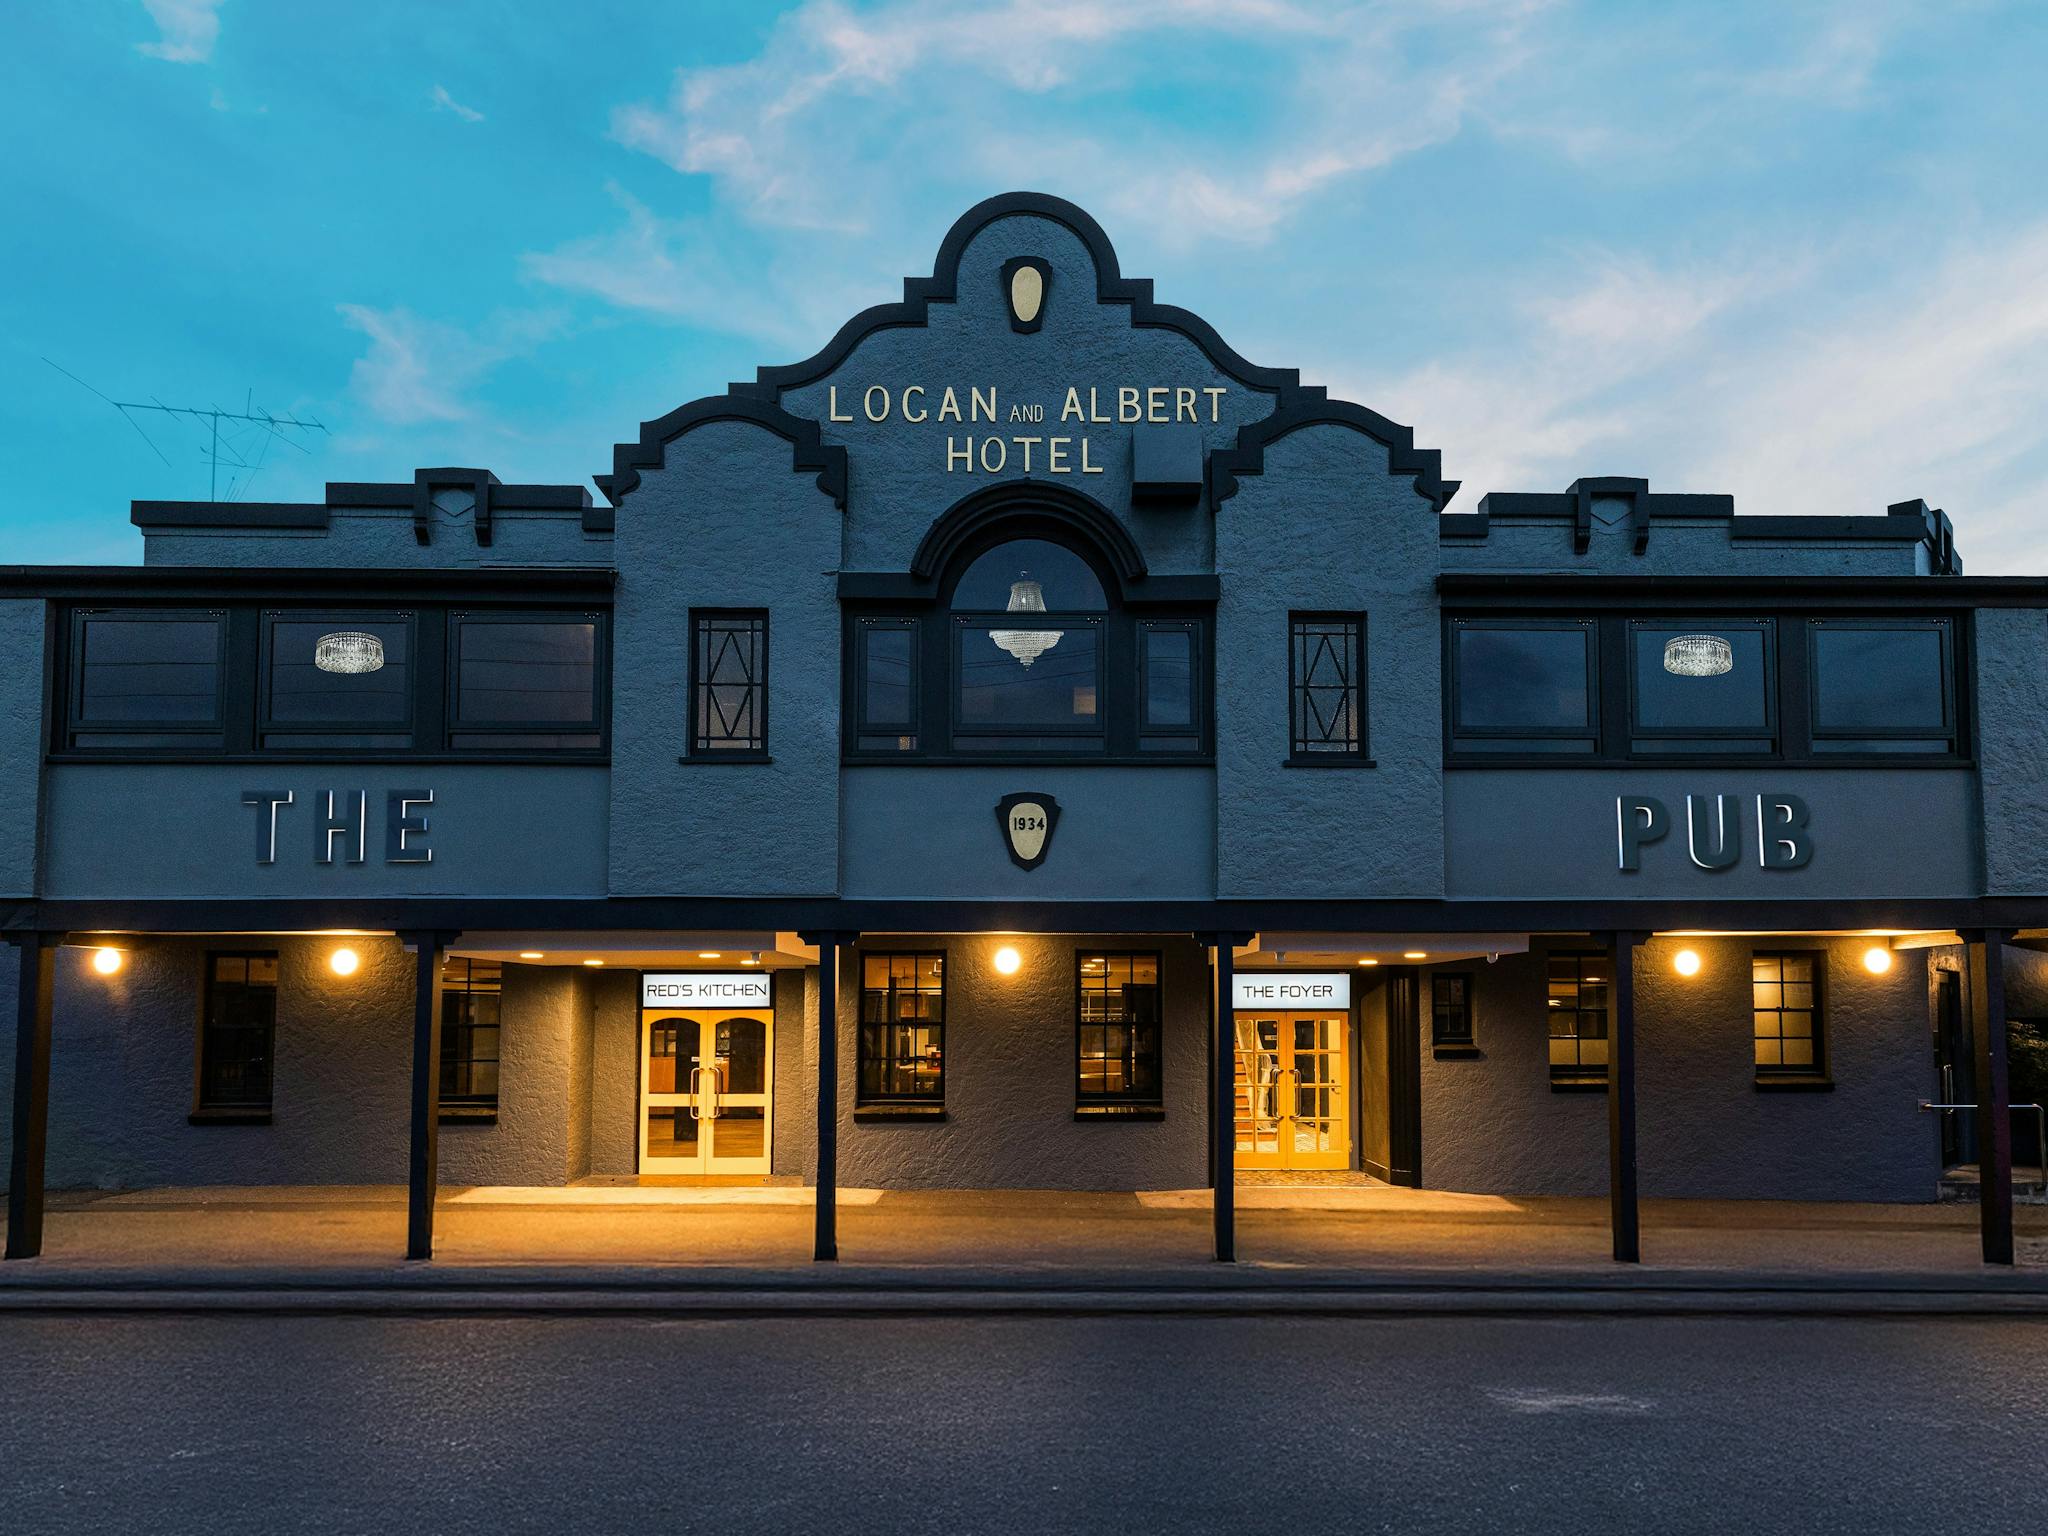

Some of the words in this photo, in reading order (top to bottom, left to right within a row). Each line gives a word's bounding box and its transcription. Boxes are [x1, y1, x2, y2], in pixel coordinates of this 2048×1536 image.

[829, 386, 997, 423] LOGAN
[1009, 404, 1044, 424] AND
[1060, 387, 1227, 424] ALBERT
[946, 436, 1104, 474] HOTEL
[241, 788, 434, 863] THE
[1013, 816, 1045, 831] 1934
[1616, 794, 1814, 870] PUB
[646, 984, 693, 997] RED'S
[699, 983, 767, 997] KITCHEN
[1242, 985, 1275, 998] THE
[1280, 985, 1334, 998] FOYER
